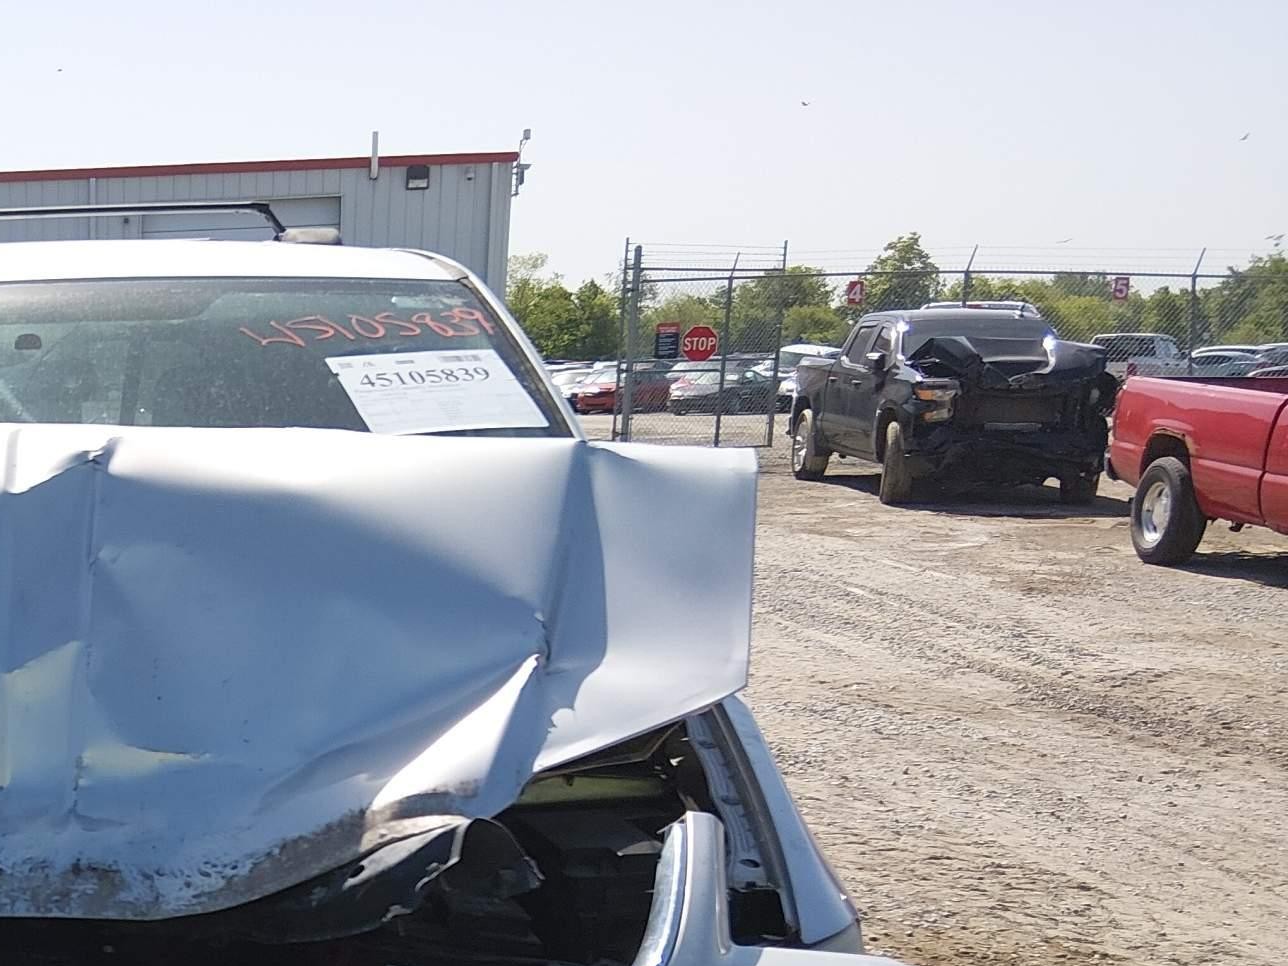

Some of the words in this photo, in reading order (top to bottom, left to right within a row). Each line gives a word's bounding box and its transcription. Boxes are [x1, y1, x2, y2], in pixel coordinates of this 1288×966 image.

[849, 284, 862, 302] 4
[1115, 279, 1127, 298] 5
[683, 337, 716, 351] STOP
[360, 367, 490, 388] 45105839
